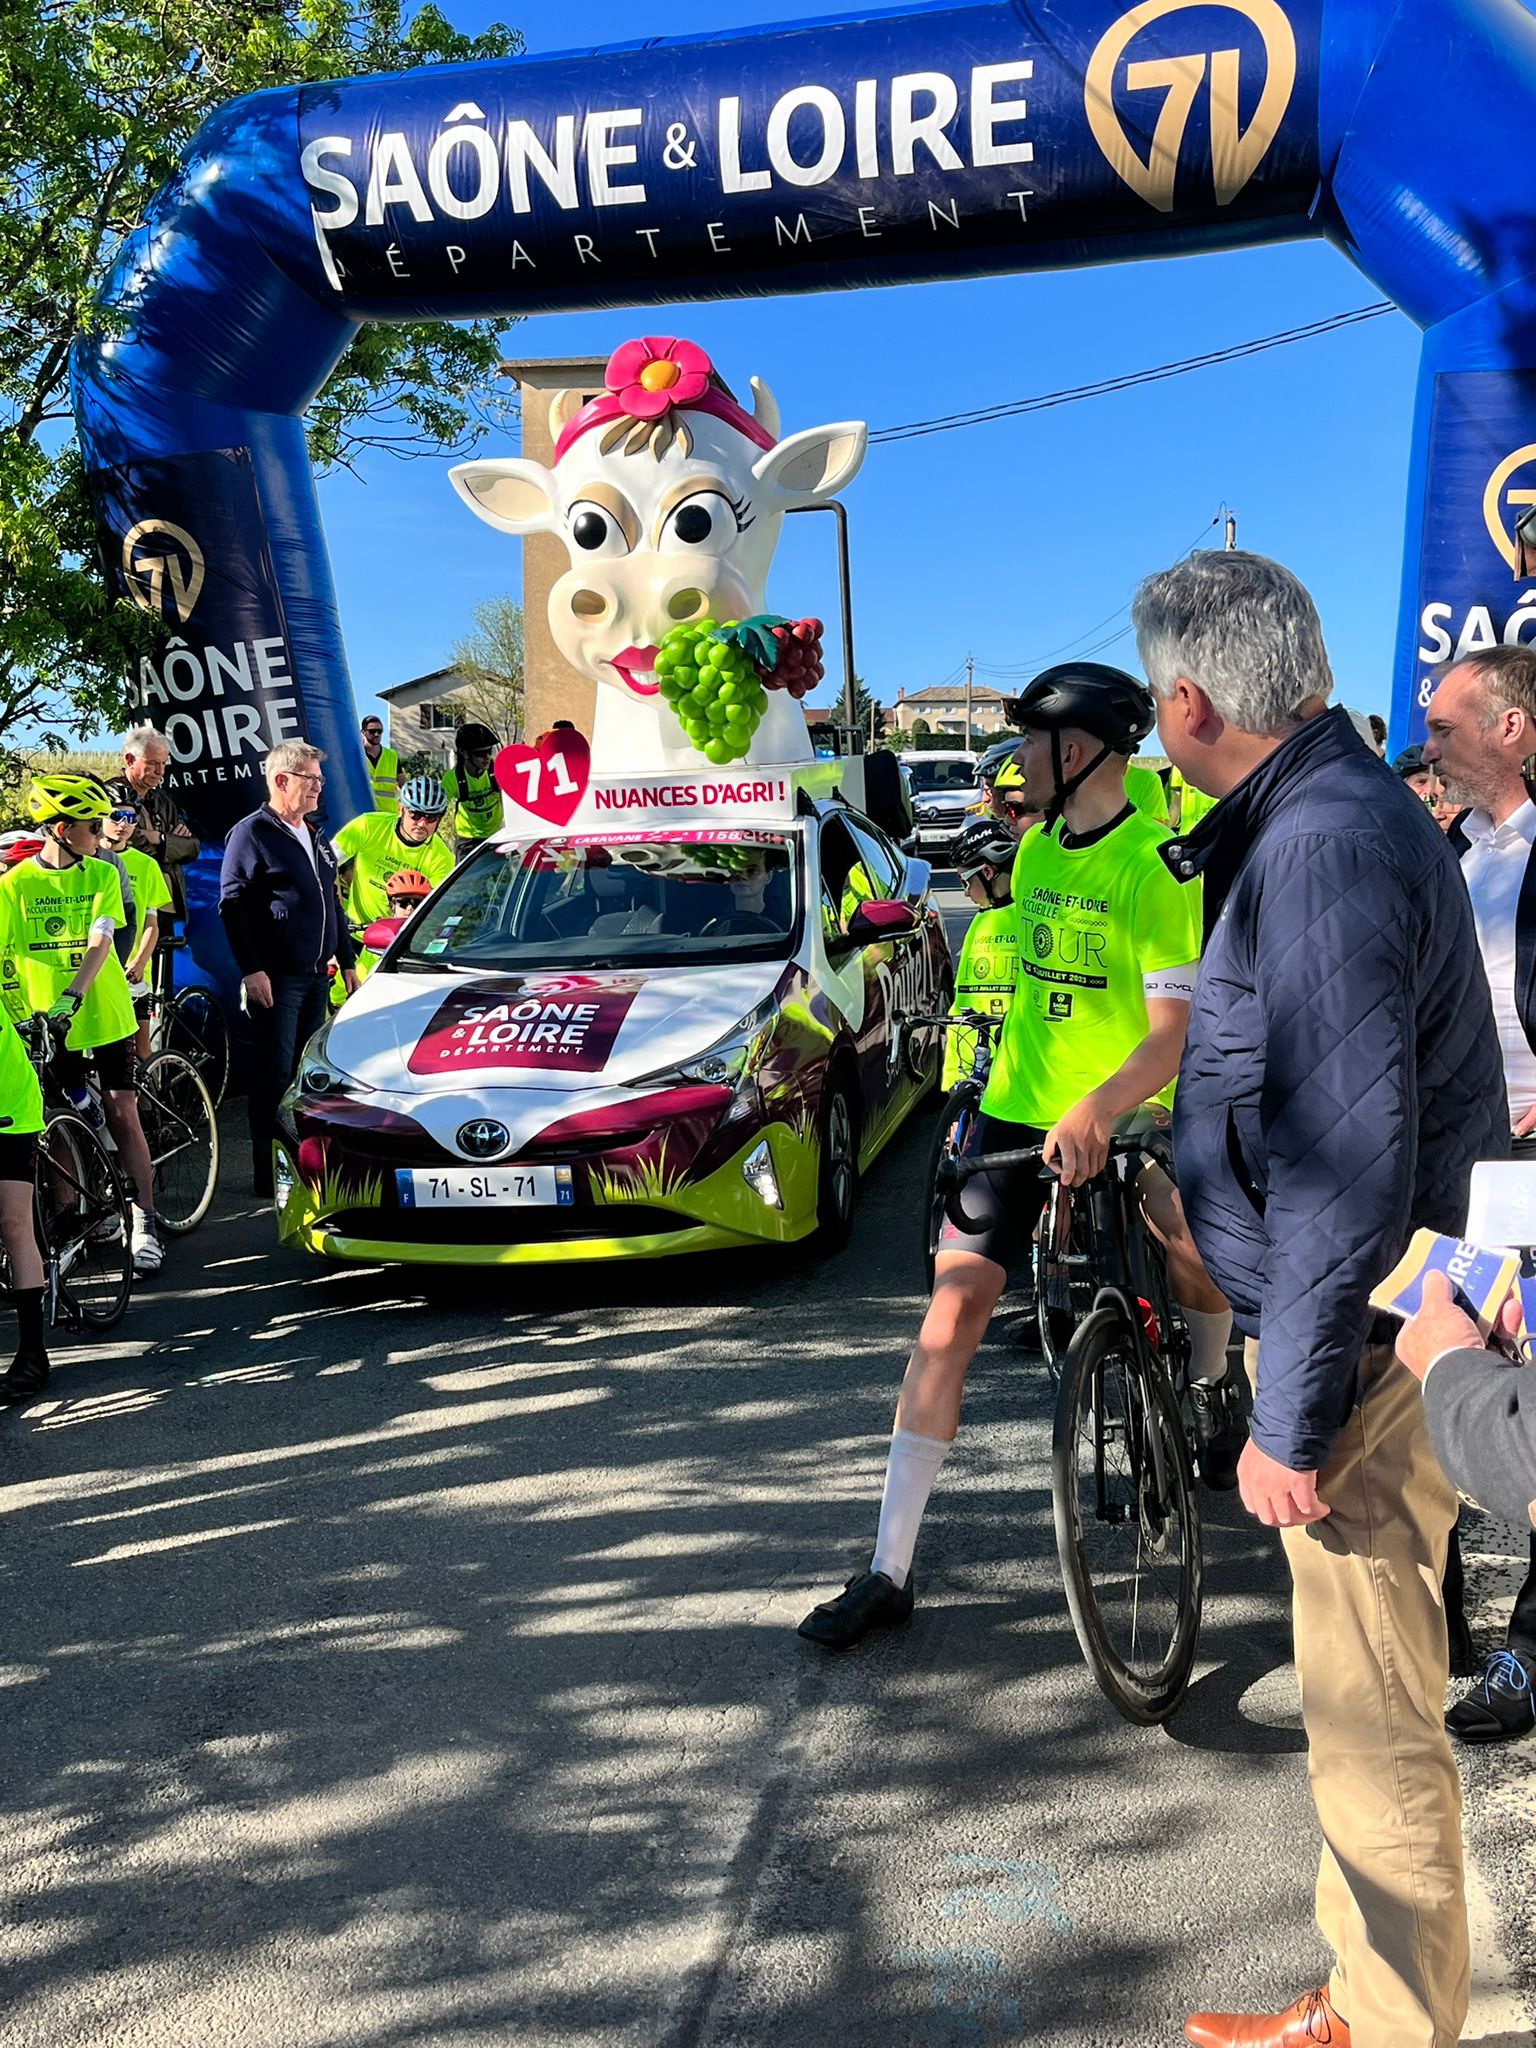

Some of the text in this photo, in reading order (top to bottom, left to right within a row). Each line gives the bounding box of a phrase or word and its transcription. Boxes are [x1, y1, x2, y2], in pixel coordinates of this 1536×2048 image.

[301, 60, 1034, 231] SAÔNE & LOIRE
[164, 697, 304, 766] OIRE
[514, 751, 579, 804] 71
[595, 785, 698, 810] NUANCES
[574, 834, 643, 845] CARAVANE
[458, 999, 600, 1025] SAÔNE
[451, 1023, 589, 1046] & LOIRE
[439, 1044, 584, 1058] DÉPARTEMENT
[560, 1190, 570, 1200] 71
